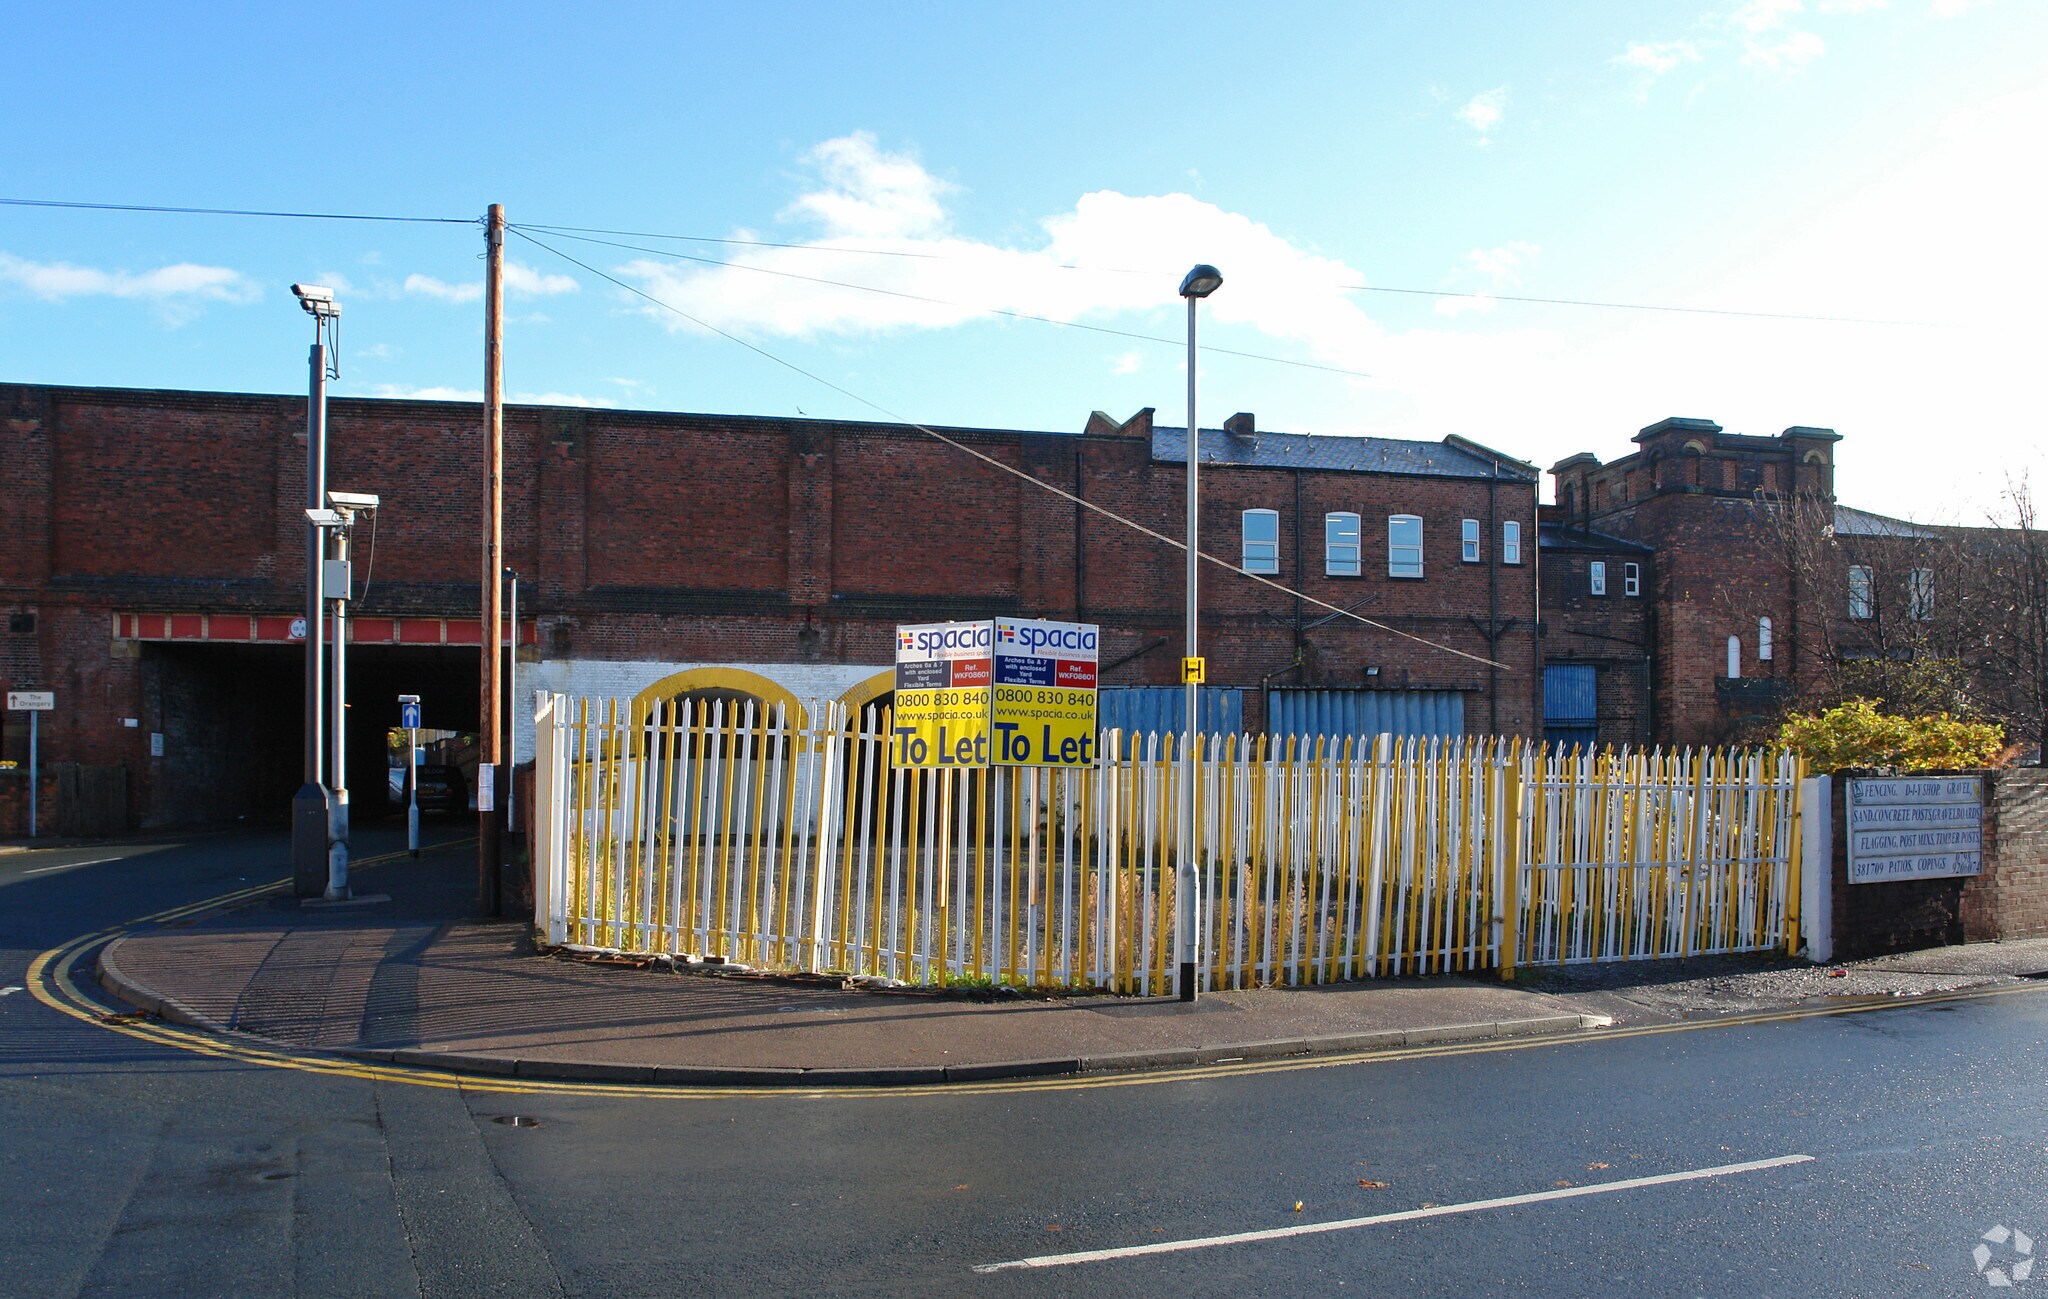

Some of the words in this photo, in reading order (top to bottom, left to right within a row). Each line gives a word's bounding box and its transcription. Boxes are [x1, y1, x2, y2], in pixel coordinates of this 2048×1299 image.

[917, 624, 990, 658] spacia
[1019, 626, 1096, 655] spacia
[904, 662, 922, 670] Arches
[1069, 665, 1083, 673] Ref.
[897, 693, 929, 707] 0800
[933, 692, 959, 706] 830
[963, 692, 989, 705] 840
[996, 688, 1033, 703] 0800
[1037, 691, 1064, 705] 830
[1067, 693, 1094, 707] 840
[897, 708, 988, 722] www.spacia.co.uk
[996, 708, 1093, 720] www.spacia.co.uk
[895, 726, 927, 764] To
[938, 726, 987, 764] Let
[995, 722, 1031, 762] To
[1042, 724, 1092, 765] Let
[1905, 783, 1922, 796] D-I-Y
[1899, 834, 1917, 848] POST
[1935, 831, 1960, 845] TIMBER
[1856, 862, 1884, 877] 381709
[1917, 857, 1947, 871] COPINGS
